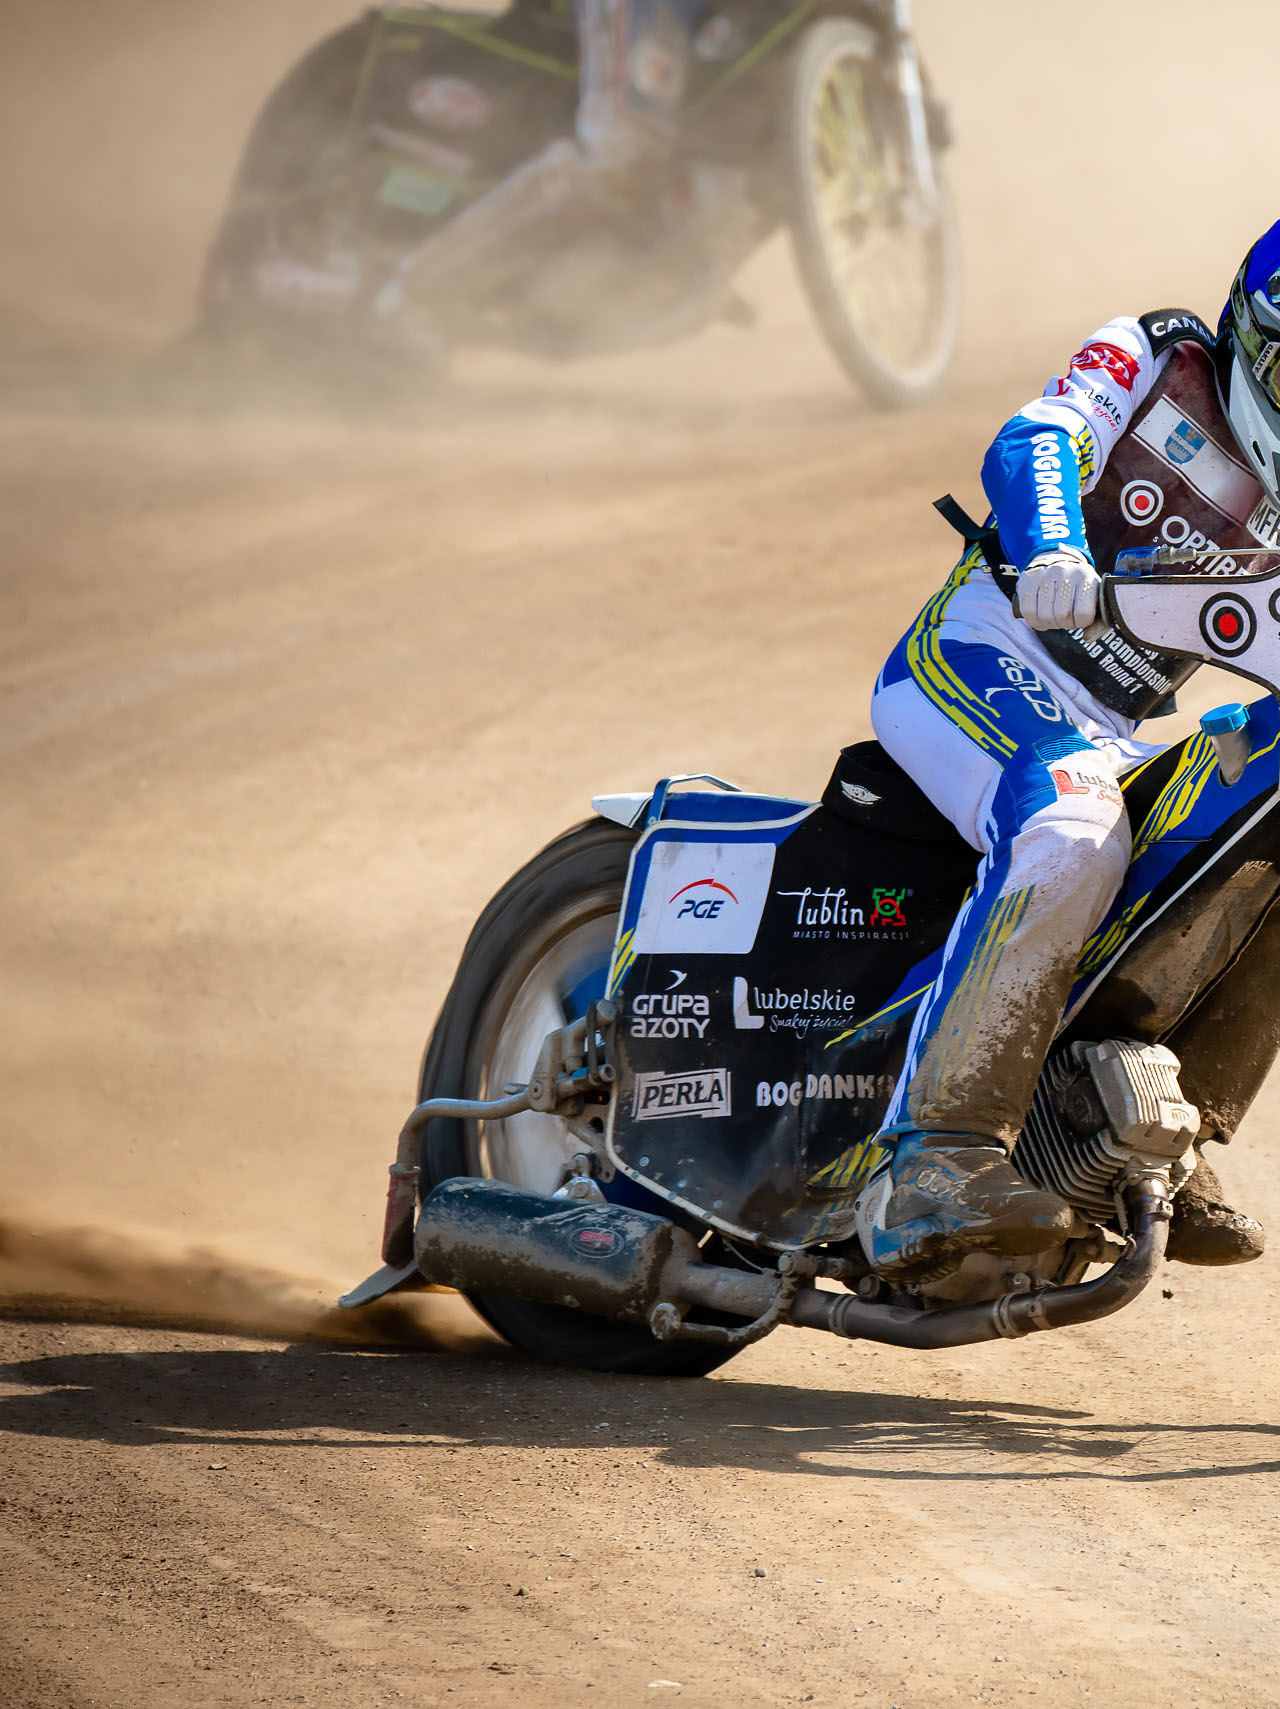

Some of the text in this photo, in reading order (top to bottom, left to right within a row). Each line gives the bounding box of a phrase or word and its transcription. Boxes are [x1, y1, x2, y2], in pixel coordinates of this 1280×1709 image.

[1099, 653, 1144, 695] Round 1
[1101, 628, 1172, 695] hampionship
[677, 900, 726, 919] PGE
[792, 930, 831, 940] MIASTO
[640, 1078, 724, 1109] PERŁA
